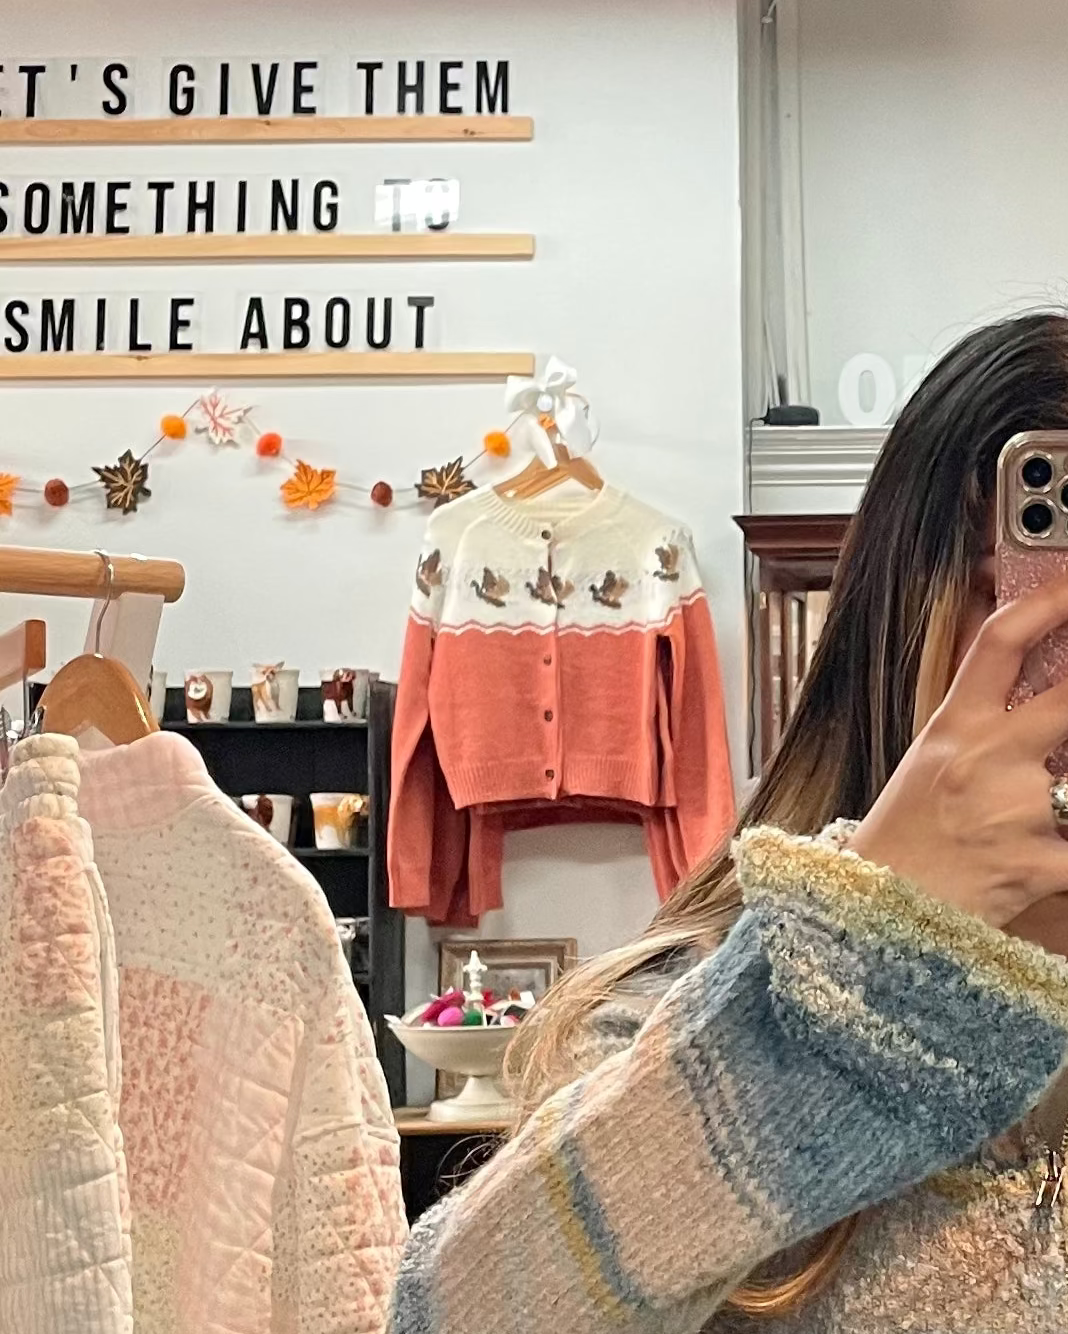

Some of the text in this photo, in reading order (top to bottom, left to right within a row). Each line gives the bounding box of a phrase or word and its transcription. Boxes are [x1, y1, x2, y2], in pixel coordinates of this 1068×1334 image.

[0, 60, 510, 118] T'S GIVE THEM
[4, 295, 434, 352] SMILE ABOUT
